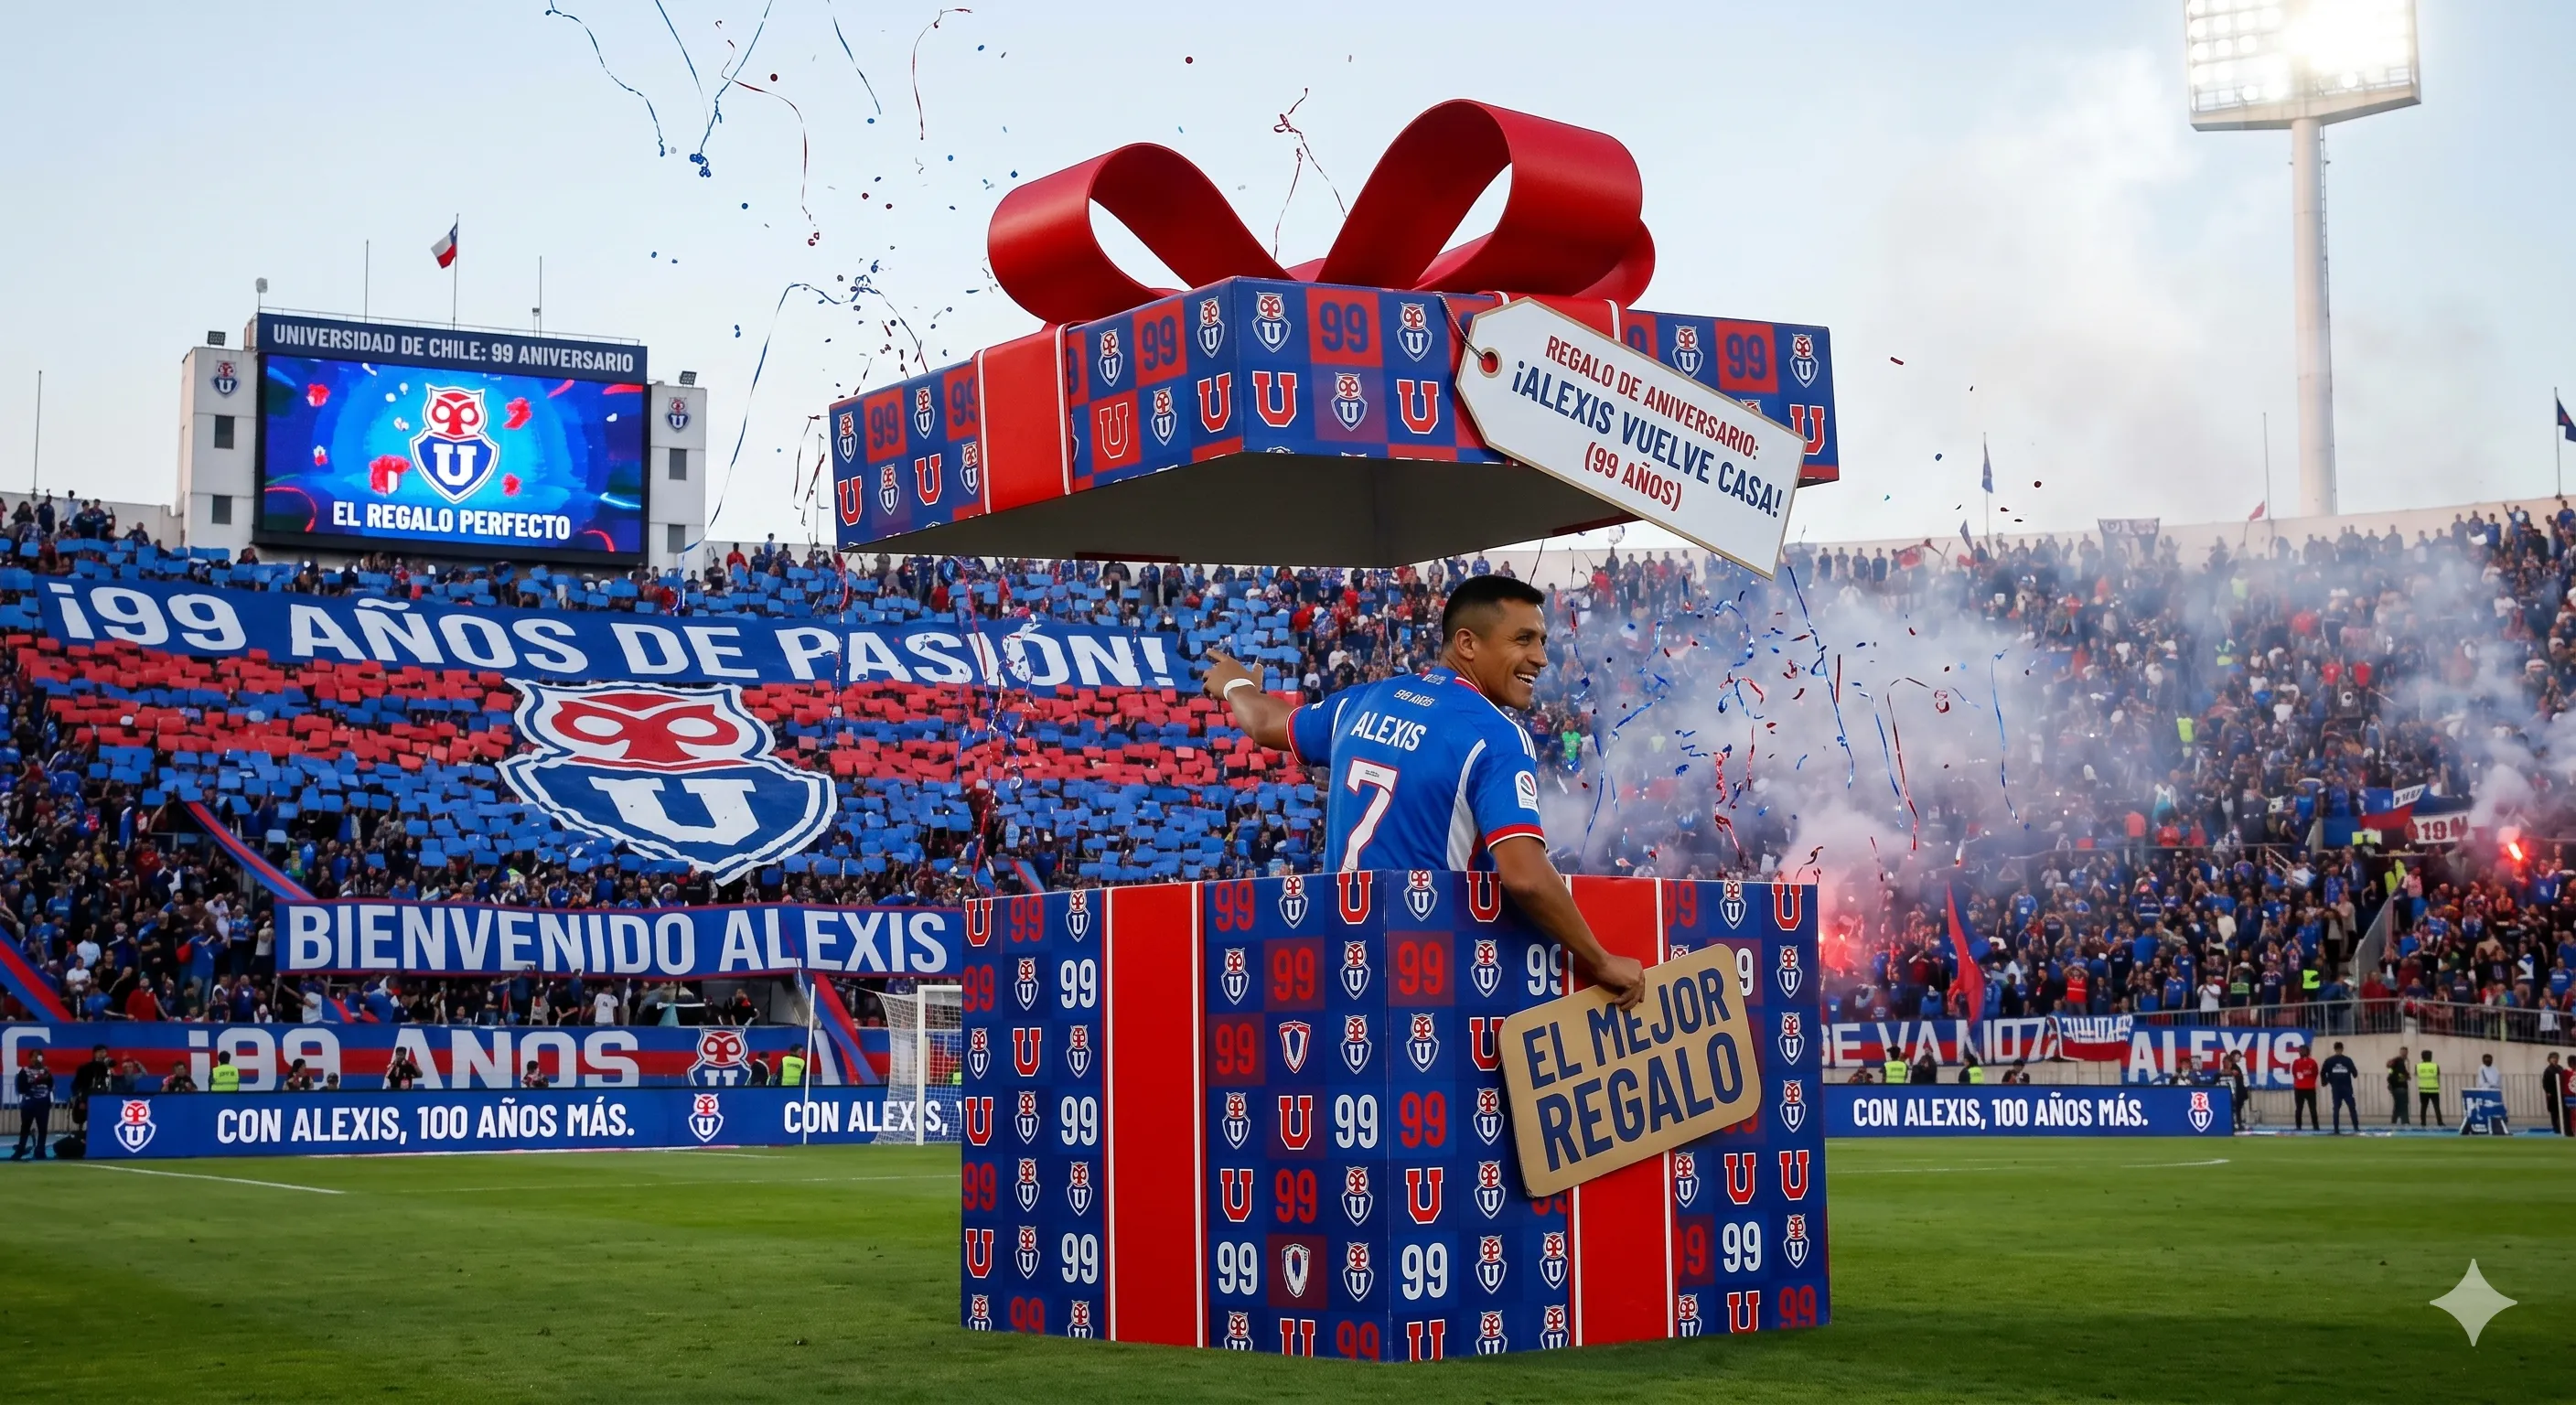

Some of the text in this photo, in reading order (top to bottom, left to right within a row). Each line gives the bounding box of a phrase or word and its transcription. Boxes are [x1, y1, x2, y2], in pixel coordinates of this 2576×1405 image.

[274, 324, 634, 373] UNIVERSIDAD DE CHILE: 99 ANIVERSARIO
[1142, 313, 1177, 373] 99
[1319, 302, 1368, 354] 99
[1726, 334, 1766, 381] 99
[1197, 371, 1232, 434] U
[1252, 370, 1298, 427] U
[1397, 379, 1439, 434] U
[1545, 335, 1614, 388] REGALO
[1617, 372, 1643, 402] DE
[1646, 385, 1760, 460] ANIVERSARIO:
[872, 401, 899, 450] 99
[1100, 401, 1129, 460] U
[1512, 360, 1783, 519] ¡ALEXIS VUELVE CASA!
[434, 443, 478, 487] U
[915, 453, 942, 507] U
[1584, 441, 1682, 511] (99 AÑOS)
[333, 501, 571, 541] EL REGALO PERFECTO
[838, 476, 862, 527] U
[48, 582, 249, 652] ¡99
[289, 598, 590, 674] AÑOS
[610, 623, 759, 679] DE
[1350, 711, 1426, 752] ALEXIS
[1339, 757, 1399, 870] 7
[1010, 896, 1044, 943] 99
[1215, 879, 1255, 931] 99
[1337, 871, 1372, 925] U
[1466, 871, 1501, 922] U
[1772, 884, 1802, 931] U
[288, 905, 948, 976] BIENVENIDO ALEXIS
[965, 899, 993, 947] U
[963, 965, 994, 1012] 99
[1060, 959, 1096, 1008] 99
[1273, 947, 1315, 1001] 99
[1398, 940, 1444, 995] 99
[1013, 1027, 1042, 1077] U
[1216, 1023, 1255, 1076] 99
[1469, 1017, 1506, 1071] U
[1522, 968, 1731, 1090] EL MEJOR
[218, 1096, 635, 1145] CON ALEXIS, 100 AÑOS MÁS.
[784, 1101, 839, 1133] CON
[848, 1100, 948, 1136] ALEXS,
[966, 1097, 993, 1146] U
[1061, 1096, 1097, 1145] 99
[1279, 1096, 1312, 1150] U
[1335, 1095, 1379, 1149] 99
[1400, 1091, 1446, 1148] 99
[1536, 1033, 1744, 1173] REGALO
[1853, 1091, 2149, 1130] CON ALEXIS, 100 AÑOS MÁS.
[962, 1162, 995, 1211] 99
[1220, 1168, 1253, 1222] U
[1275, 1168, 1317, 1224] 99
[1406, 1167, 1443, 1224] U
[1724, 1153, 1756, 1205] U
[1779, 1150, 1809, 1201] U
[966, 1228, 993, 1279] U
[1062, 1232, 1098, 1284] 99
[1218, 1241, 1258, 1295] 99
[1401, 1242, 1447, 1300] 99
[1723, 1221, 1762, 1272] 99
